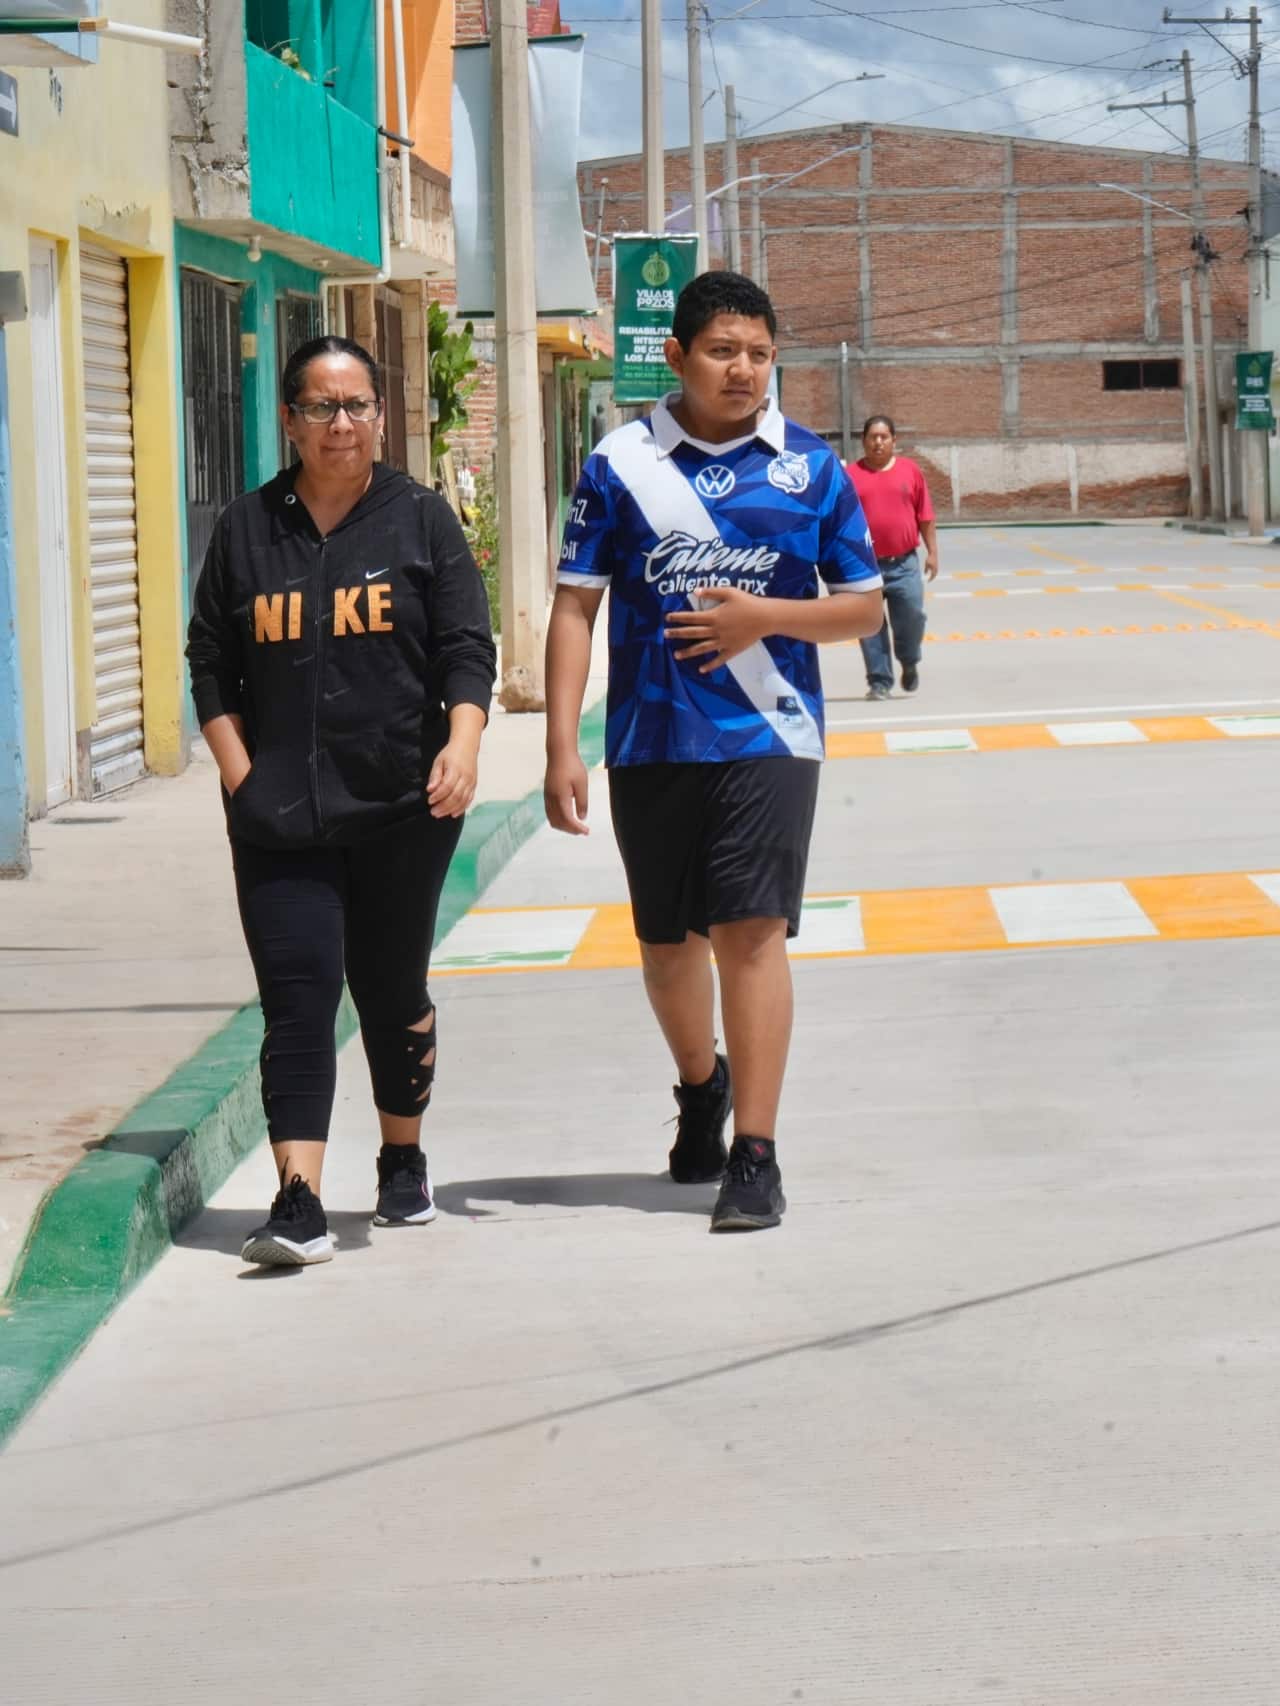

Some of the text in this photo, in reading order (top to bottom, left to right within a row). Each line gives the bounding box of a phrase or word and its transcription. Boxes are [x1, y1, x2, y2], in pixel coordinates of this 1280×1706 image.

[636, 289, 661, 298] VILLA
[618, 327, 672, 336] REHABILITA
[634, 345, 647, 353] DE
[624, 353, 643, 362] LOS
[641, 530, 780, 583] Caliente
[658, 573, 768, 596] calientemx
